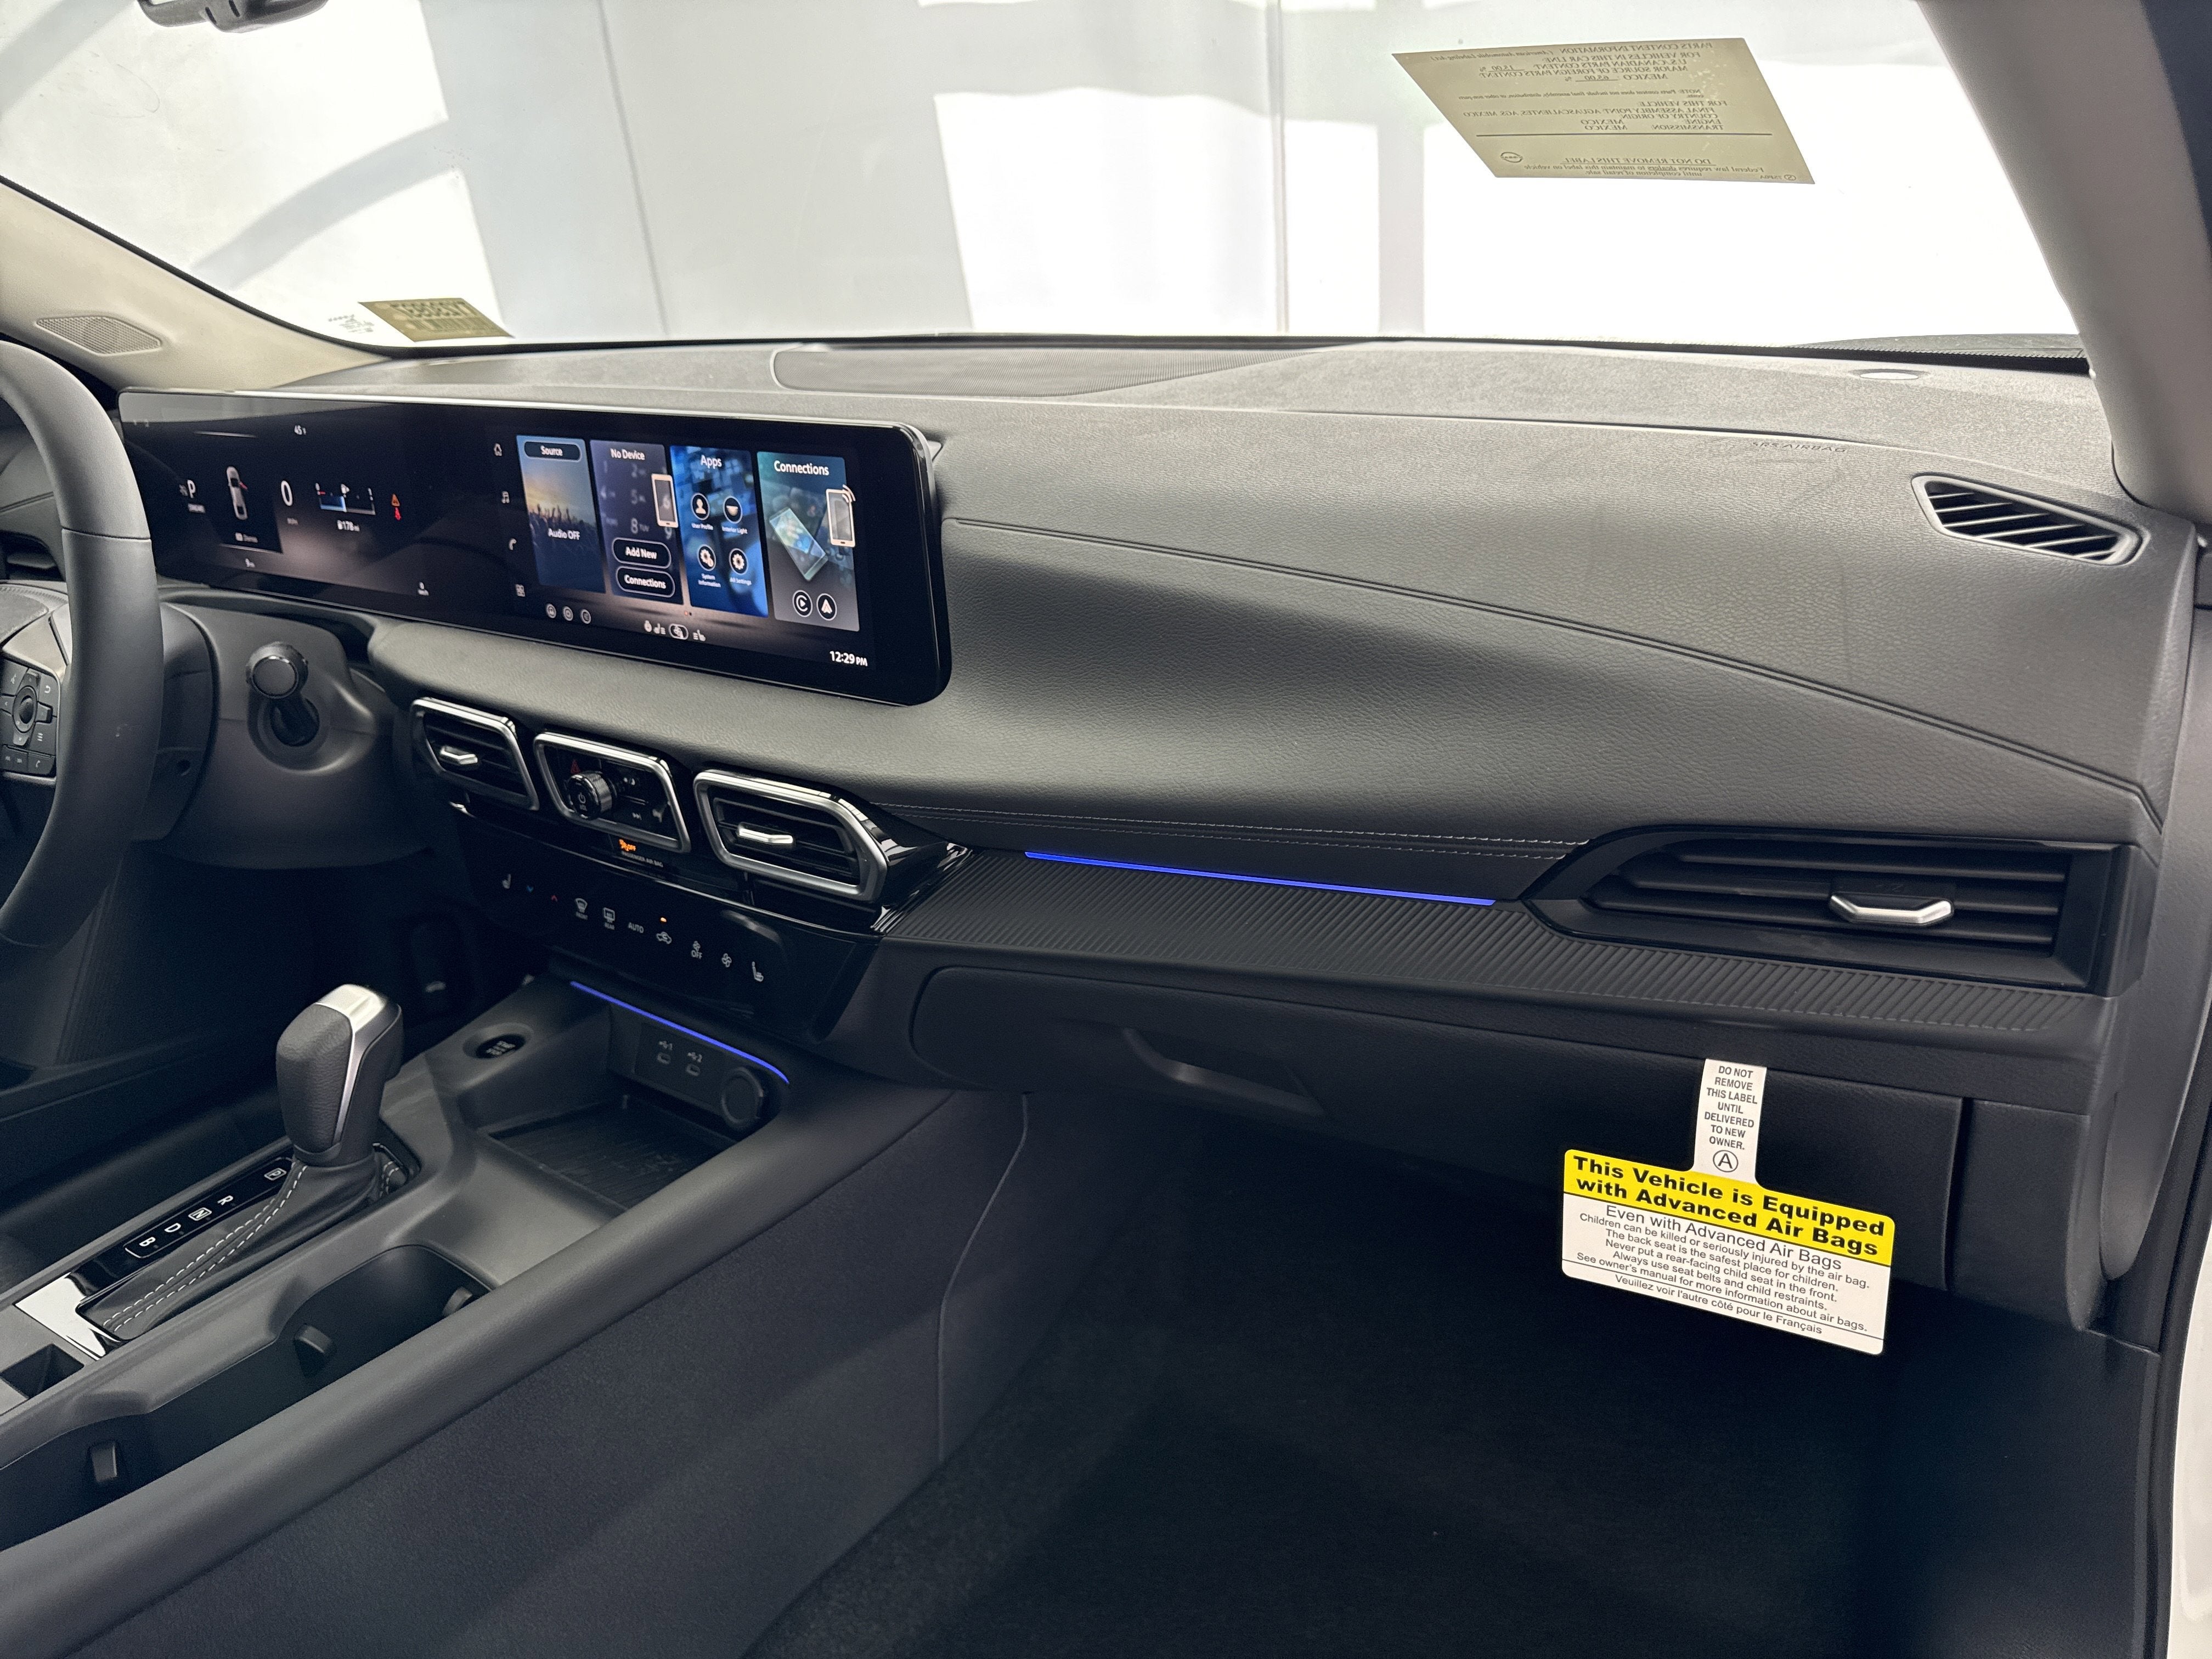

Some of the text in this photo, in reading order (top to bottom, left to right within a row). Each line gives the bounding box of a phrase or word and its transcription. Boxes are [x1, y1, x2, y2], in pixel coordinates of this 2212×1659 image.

[540, 445, 563, 456] Source
[610, 448, 645, 461] No Device
[1782, 444, 1847, 452] AIRBAG
[701, 455, 723, 469] Apps
[774, 460, 830, 476] Connections
[187, 479, 196, 498] P
[281, 480, 293, 506] 0
[548, 527, 580, 540] Audio OFF
[625, 546, 657, 560] Add New
[624, 574, 667, 589] Connections
[830, 651, 868, 667] 12:29 PM
[628, 922, 644, 934] AUTO
[691, 950, 703, 960] OFF
[1719, 1066, 1753, 1078] DO NOT
[1715, 1077, 1752, 1091] REMOVE
[1707, 1087, 1757, 1104] THIS LABEL
[1718, 1102, 1743, 1114] UNTIL
[1705, 1111, 1754, 1127] DELIVERED
[1711, 1125, 1746, 1138] TO NEW
[1709, 1136, 1745, 1150] OWNER.
[217, 1195, 234, 1206] R
[1573, 1155, 1884, 1236] This Vehicle is Equipped
[1577, 1178, 1877, 1255] with Advanced Air Bags
[164, 1222, 182, 1233] D
[139, 1237, 156, 1247] B
[1607, 1205, 1841, 1269] Even with Advanced Air Bags
[1580, 1214, 1620, 1228] Children
[1624, 1224, 1641, 1233] can
[1645, 1227, 1657, 1236] be
[1661, 1231, 1686, 1243] killed
[1703, 1242, 1749, 1260] seriously
[1752, 1252, 1787, 1267] injured
[1792, 1262, 1804, 1273] by
[1808, 1266, 1824, 1276] the
[1846, 1275, 1869, 1289] bag.
[1606, 1229, 1838, 1291] The back seat is the safest place for children.
[1606, 1239, 1635, 1251] Never
[1638, 1248, 1654, 1256] put
[1666, 1254, 1720, 1274] rear-facing
[1724, 1268, 1747, 1279] child
[1751, 1275, 1773, 1286] seat
[1777, 1279, 1785, 1289] in
[1790, 1283, 1805, 1294] the
[1809, 1288, 1837, 1302] front.
[1613, 1251, 1826, 1310] Always use seat belts and child restraints.
[1577, 1252, 1866, 1331] See owner's manual for more information about air bags.
[1615, 1274, 1821, 1334] Veuillez voir l'autre côté pour le Français
